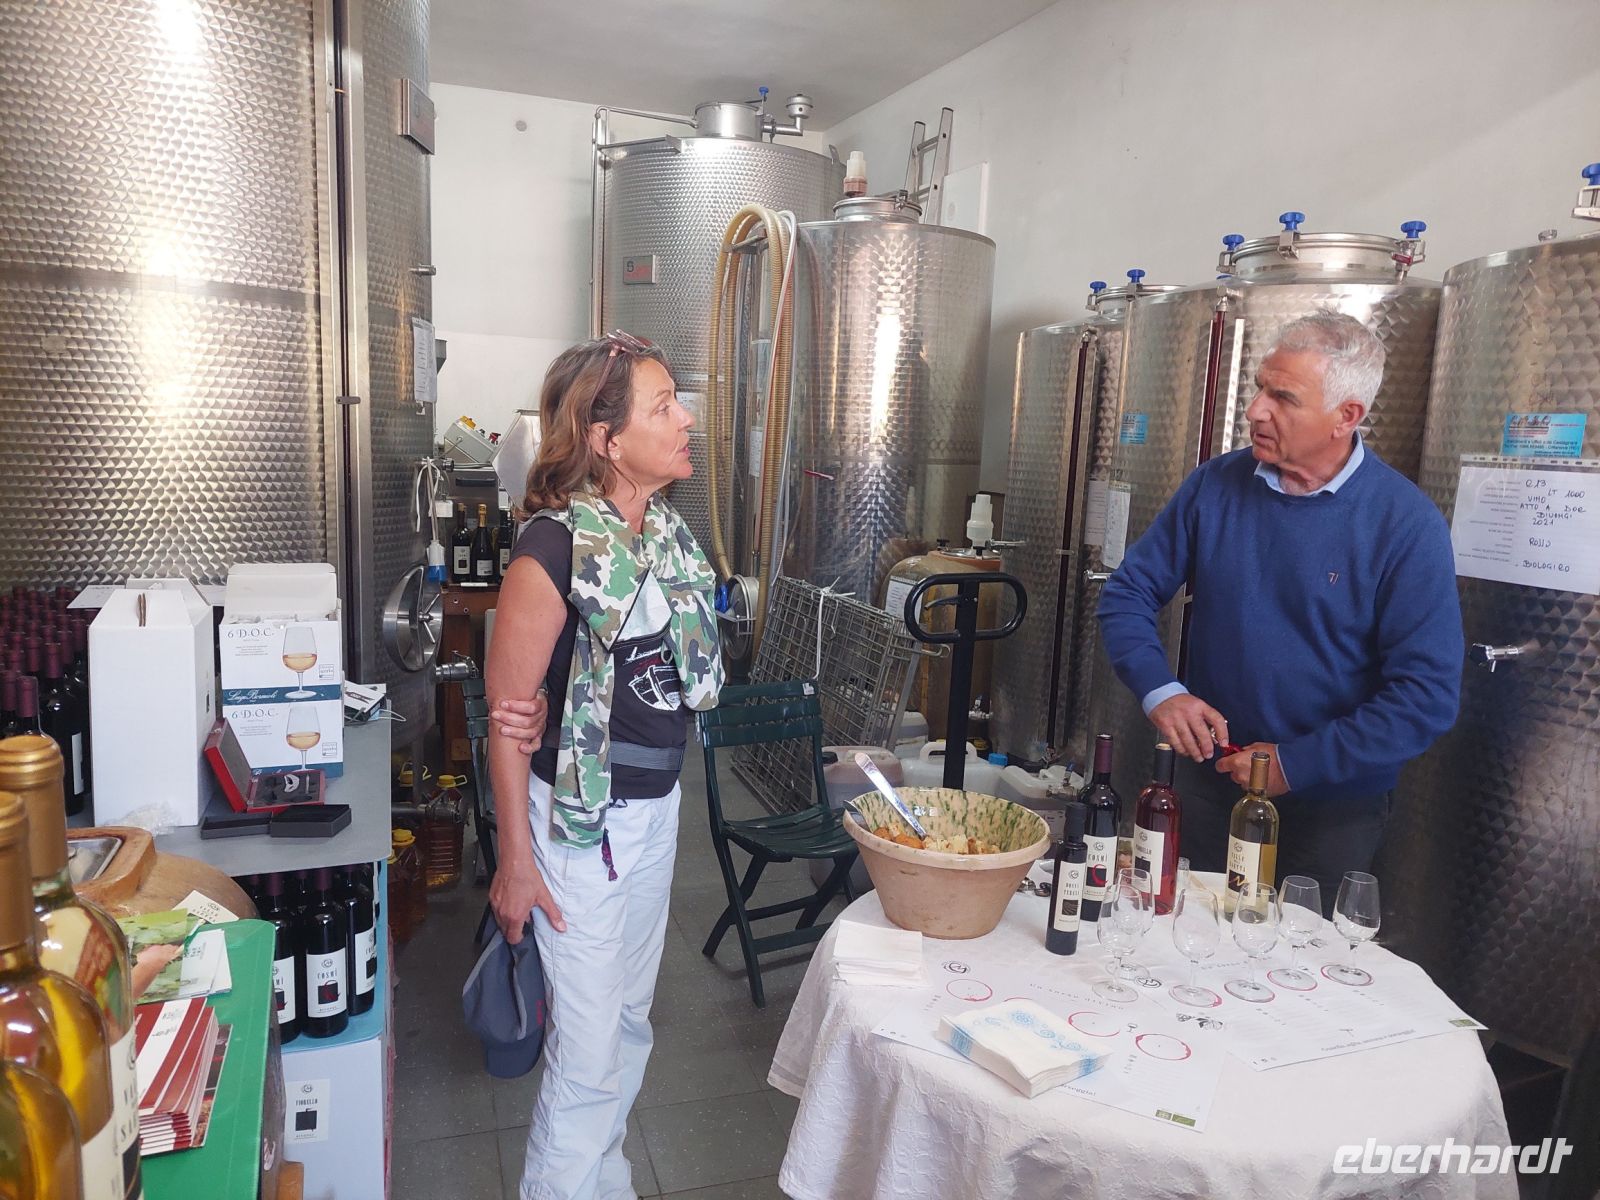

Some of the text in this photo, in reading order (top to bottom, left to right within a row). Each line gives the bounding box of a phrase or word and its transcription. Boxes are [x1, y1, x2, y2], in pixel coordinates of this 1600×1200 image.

[1564, 490, 1585, 499] 1000
[1520, 503, 1539, 511] ATTO
[1545, 504, 1551, 512] A
[1532, 517, 1554, 526] 2021
[227, 627, 275, 638] 6 D.O.C.
[231, 708, 279, 719] 6 D.O.C.
